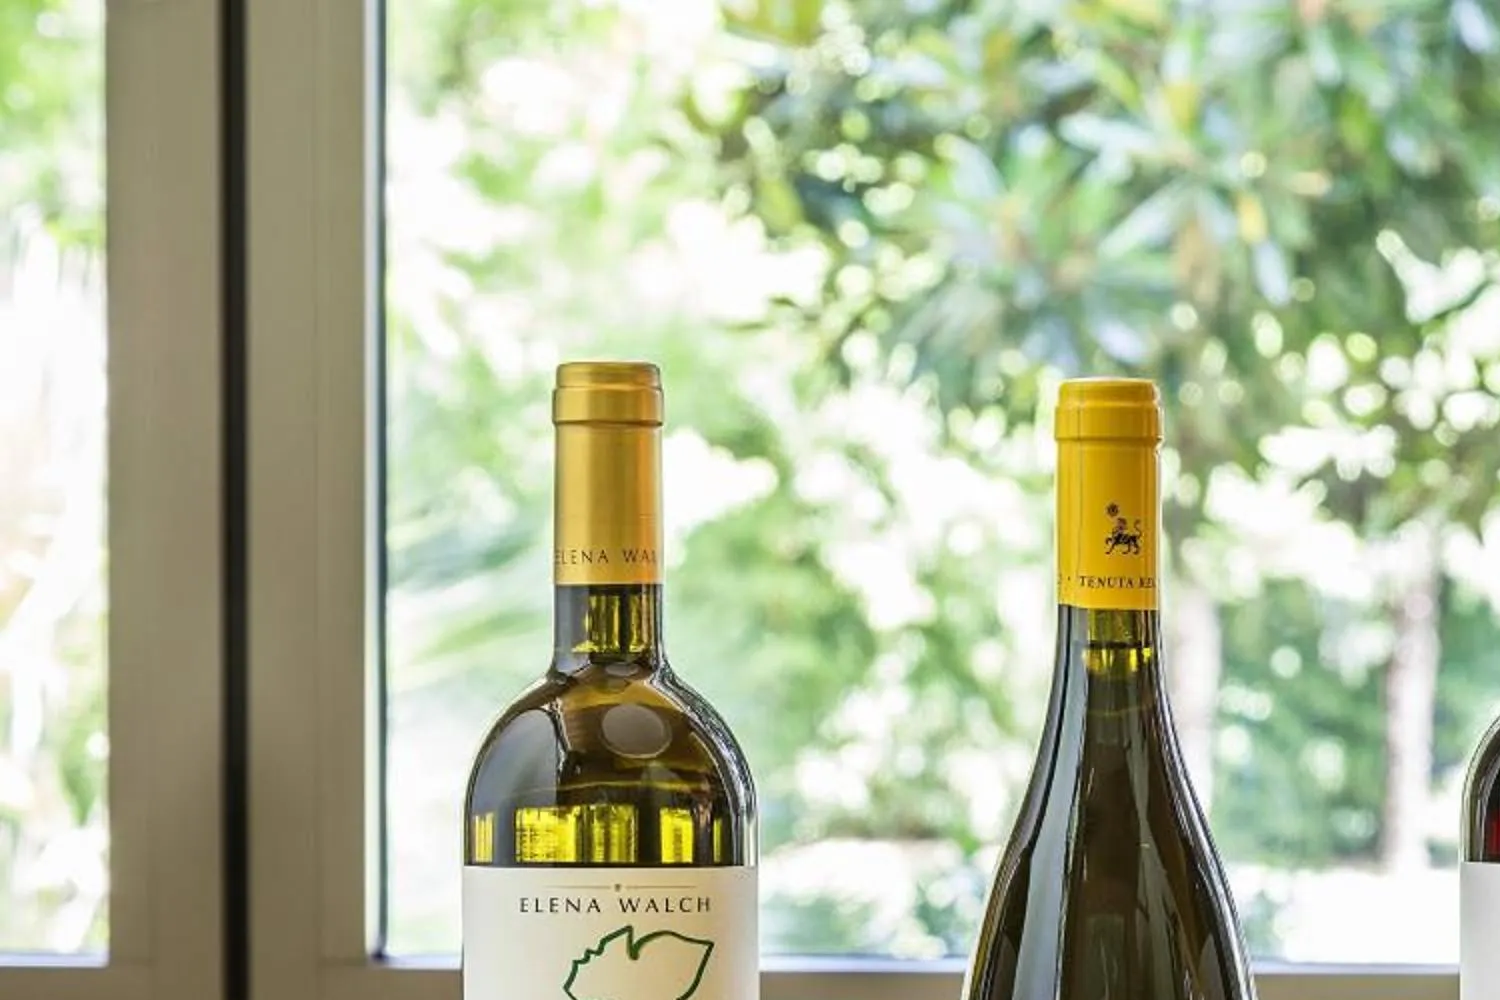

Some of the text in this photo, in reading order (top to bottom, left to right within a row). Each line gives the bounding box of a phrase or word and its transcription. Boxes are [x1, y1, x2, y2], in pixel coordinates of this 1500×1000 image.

[1080, 576, 1134, 589] TENUTA
[519, 897, 712, 913] ELENA WALCH
